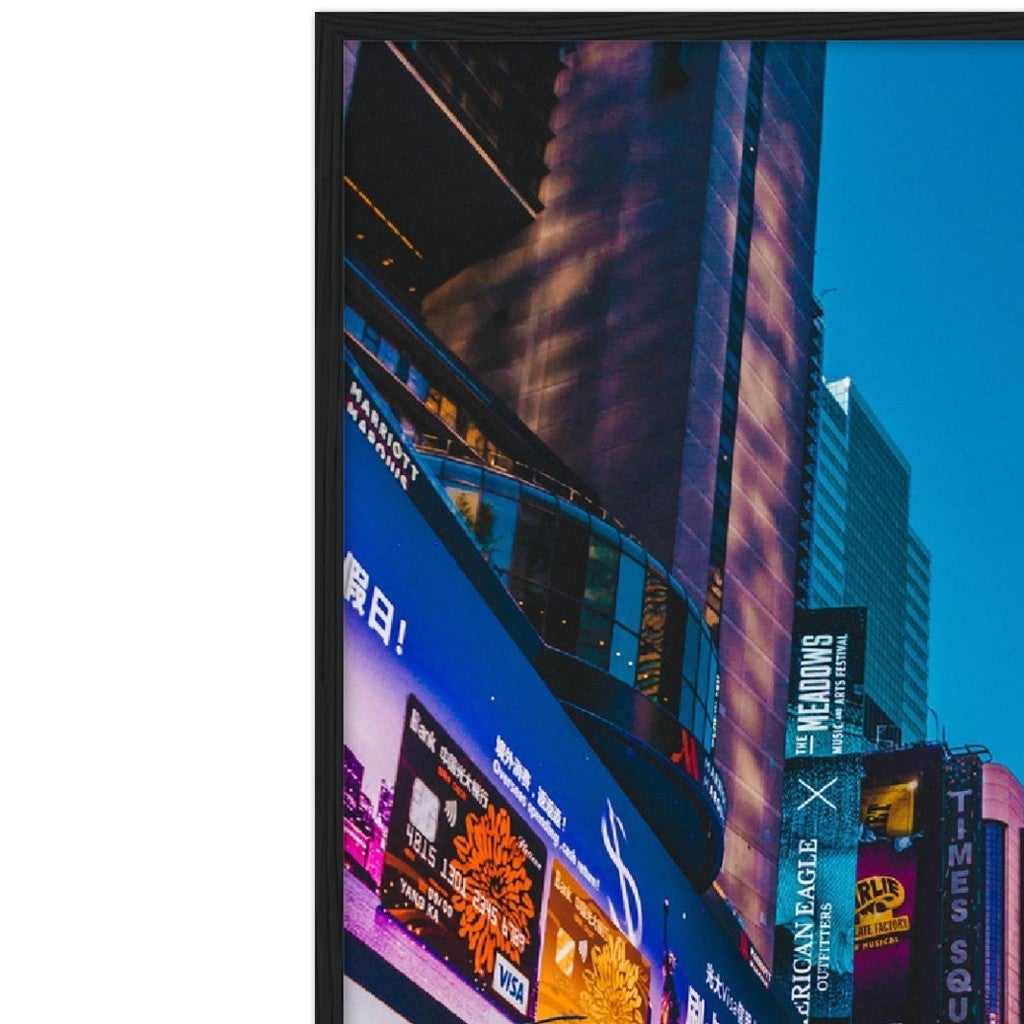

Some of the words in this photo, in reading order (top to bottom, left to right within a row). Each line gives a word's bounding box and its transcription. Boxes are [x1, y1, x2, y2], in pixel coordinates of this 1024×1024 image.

[835, 633, 848, 678] FESTIVAL
[797, 634, 833, 732] MEADOWS
[834, 680, 846, 705] ARTS
[795, 734, 808, 755] THE
[832, 721, 844, 754] MUSIC
[948, 789, 972, 923] TIMES
[796, 839, 818, 916] EAGLE
[855, 876, 900, 906] RLIE
[862, 936, 899, 950] MUSICAL
[874, 918, 908, 935] FACTORY
[817, 902, 832, 992] OUTFITTERS
[499, 963, 524, 1005] VISA
